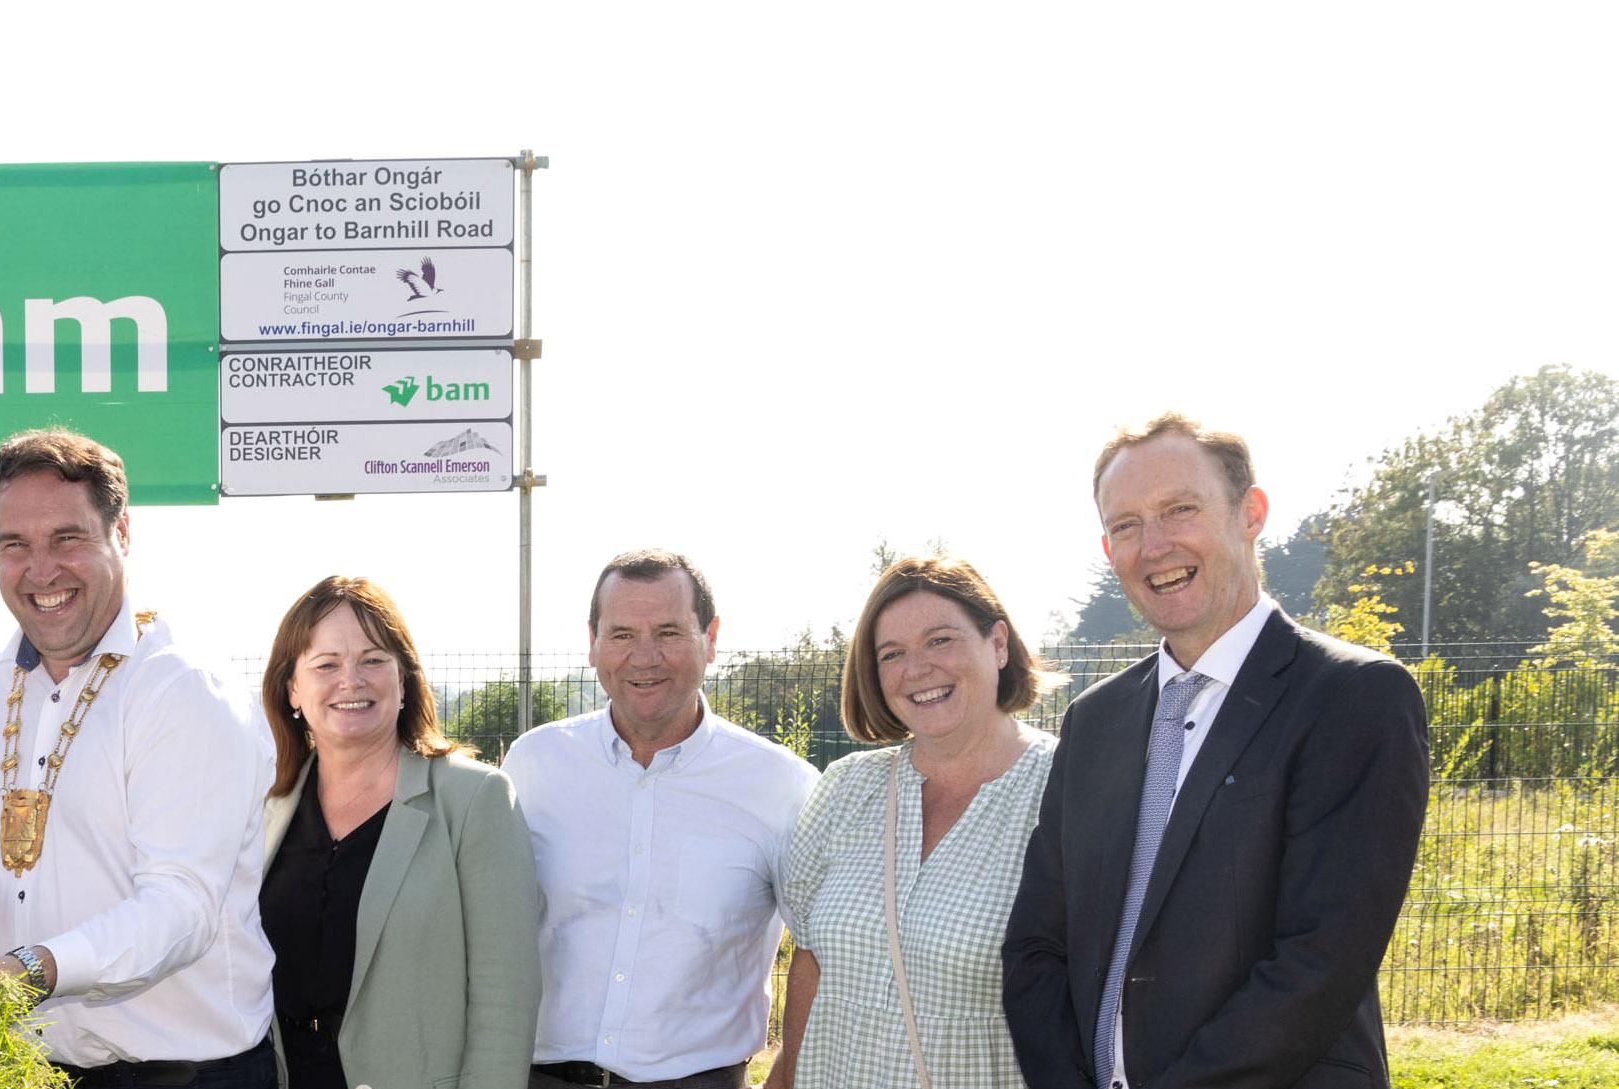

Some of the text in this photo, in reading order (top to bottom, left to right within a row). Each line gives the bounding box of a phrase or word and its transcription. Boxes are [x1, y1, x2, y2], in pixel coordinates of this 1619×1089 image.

[293, 166, 442, 189] Bóthar Ongár
[253, 191, 480, 218] go Cnoc an Sciobóil
[241, 219, 492, 245] Ongar to Barnhill Road
[284, 265, 375, 275] Comhairle Contae
[284, 278, 334, 288] Fhine Gall
[284, 291, 348, 303] Fingal County
[284, 305, 319, 314] Council
[259, 319, 475, 338] www.fingal.ie/ongar-barnhill
[229, 356, 371, 372] CONRAITHEOIR
[229, 372, 354, 388] CONTRACTOR
[427, 376, 489, 401] bam
[230, 426, 338, 445] DEARTHÓIR
[230, 446, 321, 461] DESIGNER
[365, 459, 489, 474] Clifton Scannell Emerson
[433, 473, 489, 483] Associates
